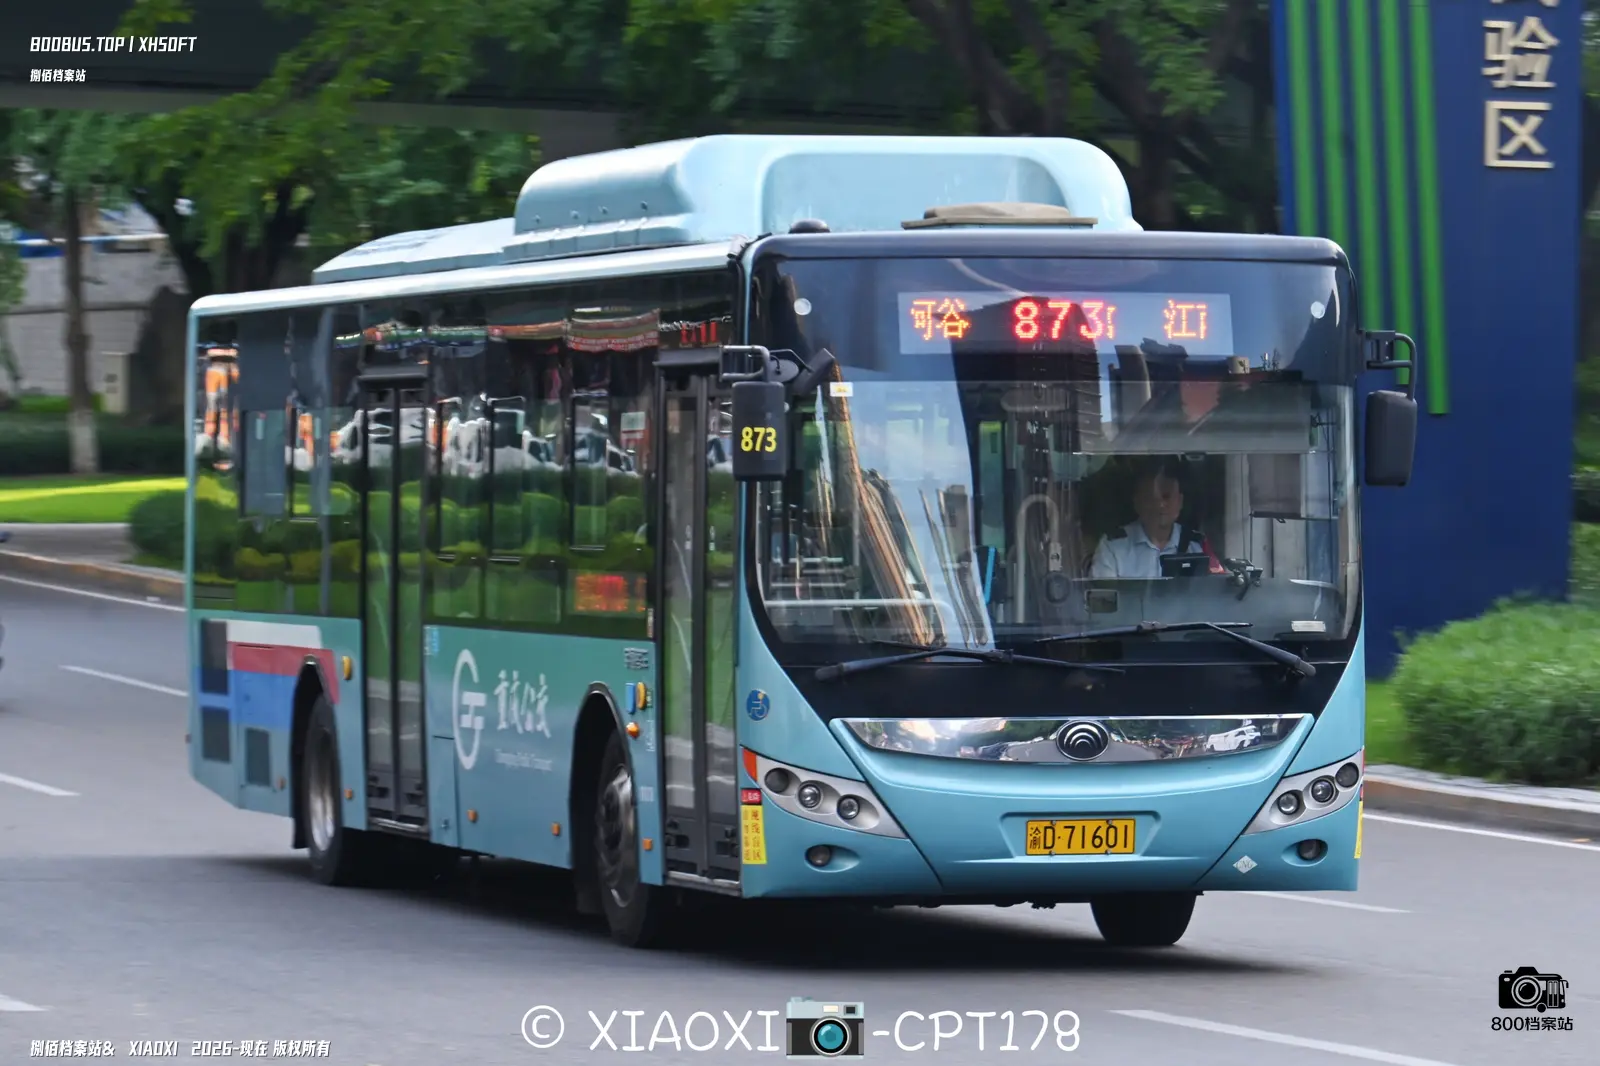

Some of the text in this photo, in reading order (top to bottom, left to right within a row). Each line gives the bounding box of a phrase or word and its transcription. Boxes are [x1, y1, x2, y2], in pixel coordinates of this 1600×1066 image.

[1481, 0, 1560, 168] 验区
[1014, 301, 1104, 340] 873
[741, 426, 777, 452] 873
